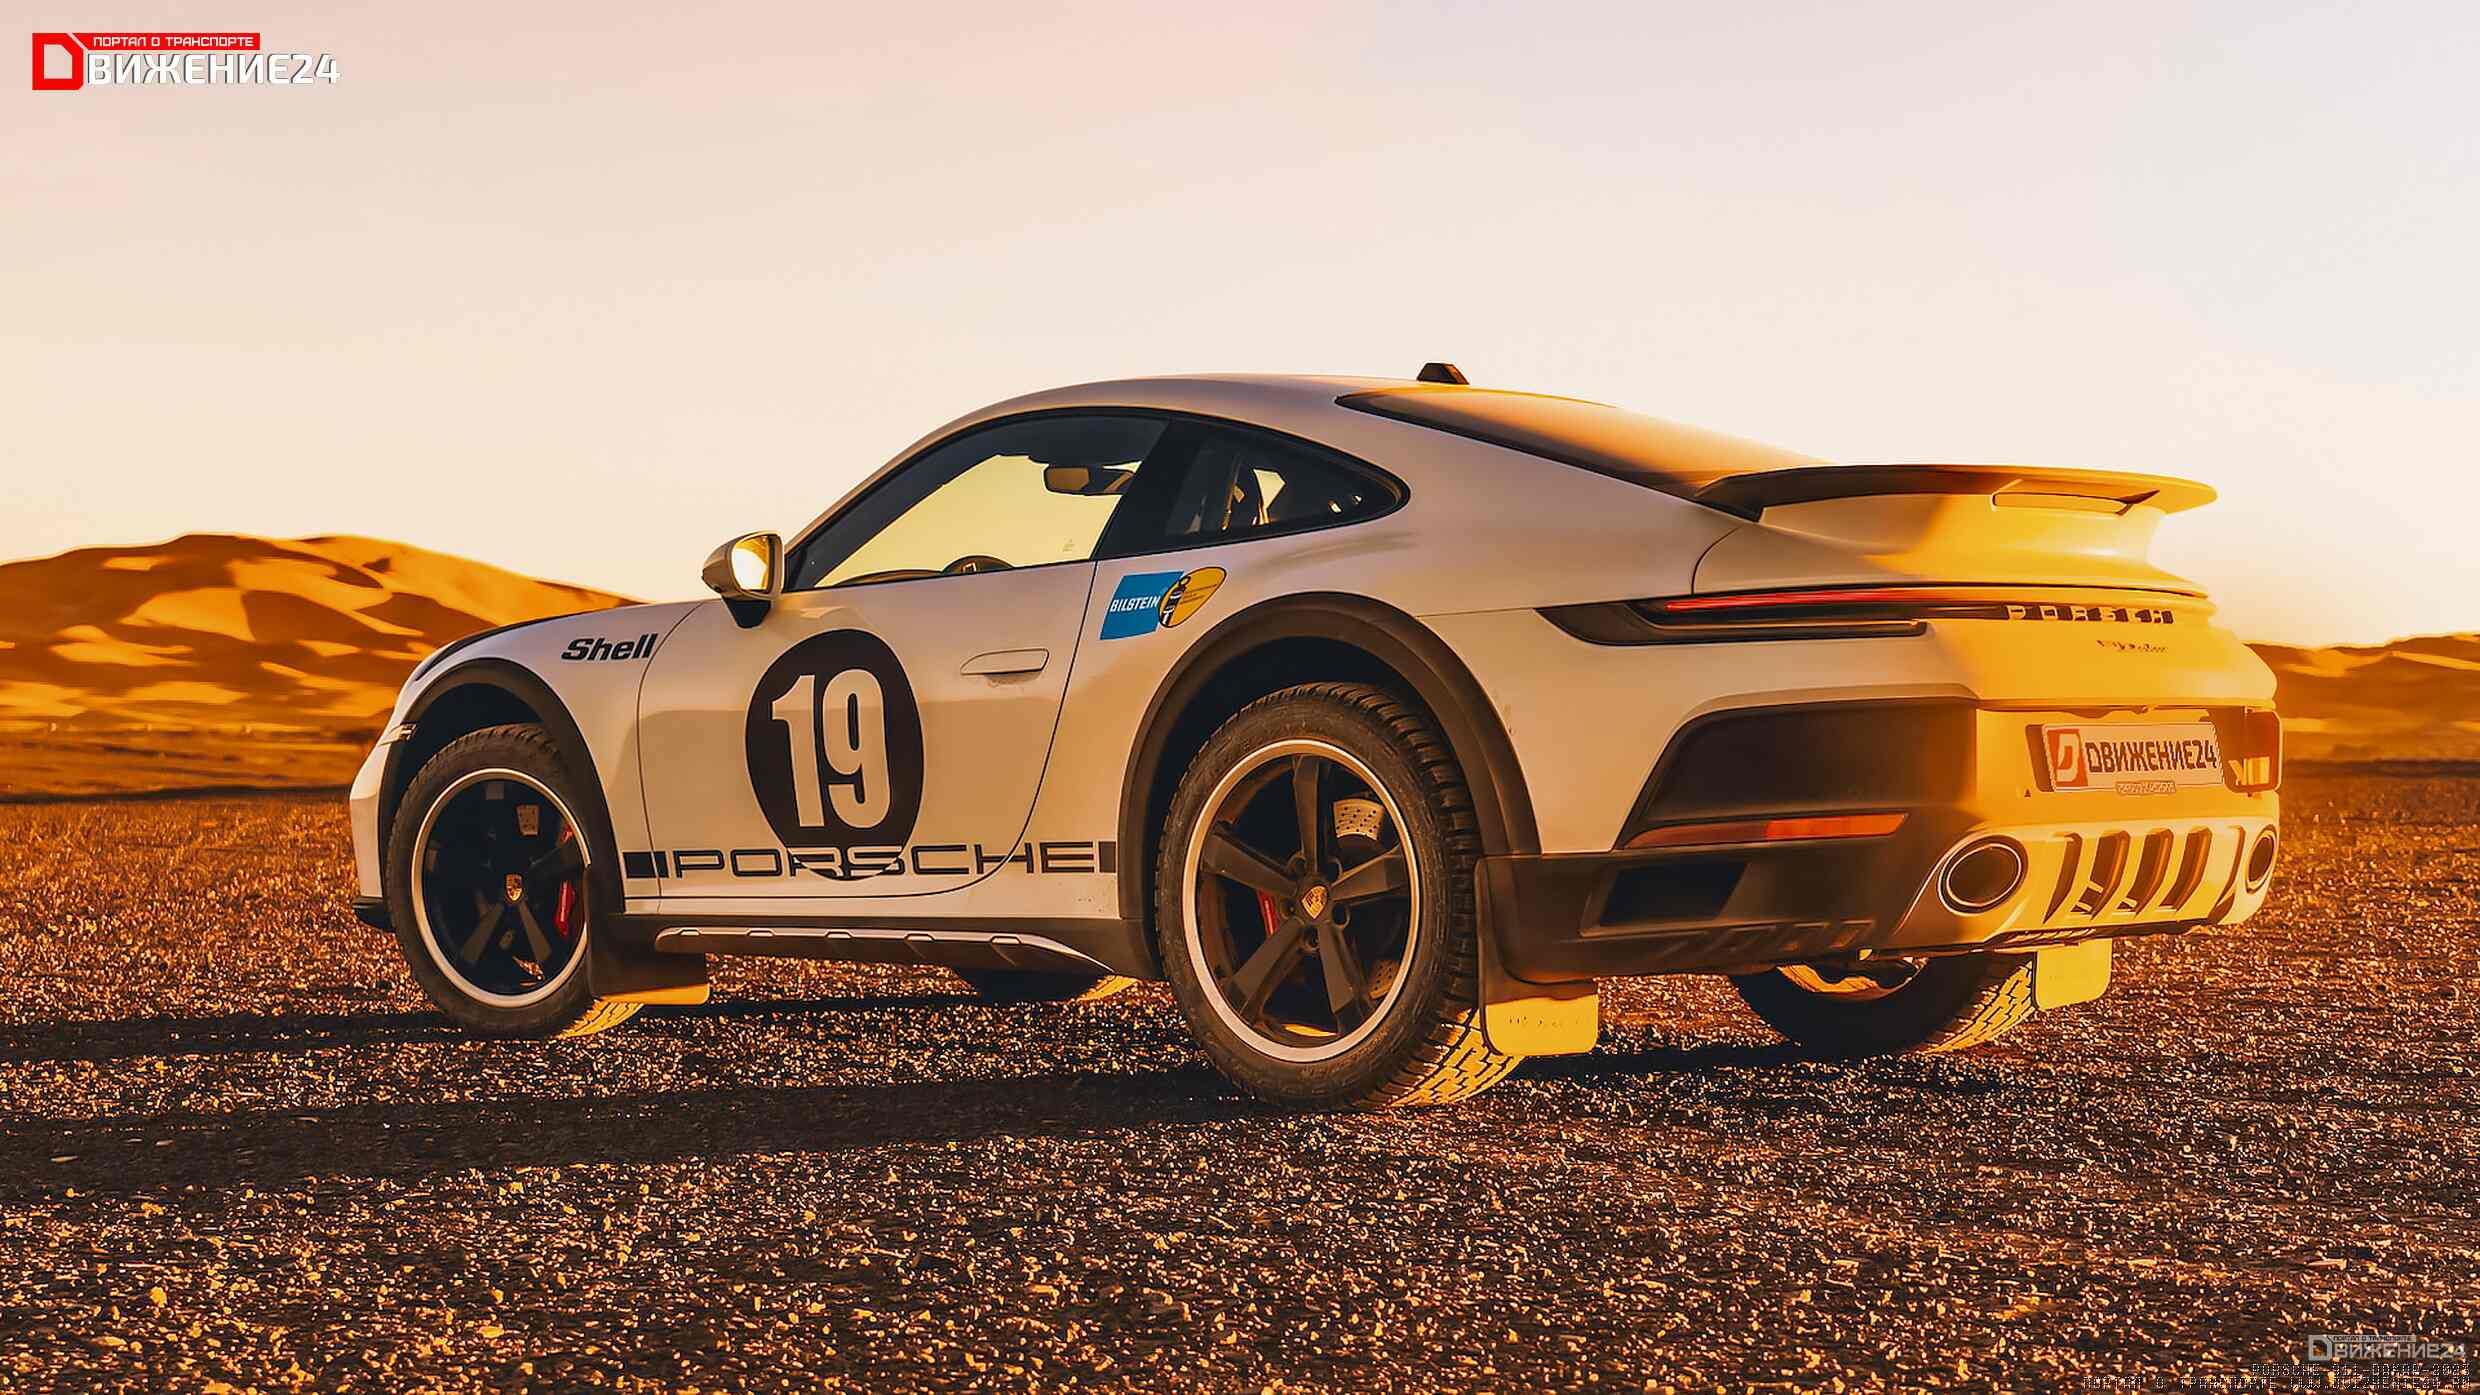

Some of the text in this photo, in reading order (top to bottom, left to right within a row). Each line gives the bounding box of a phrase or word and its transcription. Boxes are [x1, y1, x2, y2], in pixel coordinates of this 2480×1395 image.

[1109, 595, 1161, 613] BILSTEIN
[2006, 604, 2180, 625] PORSCH
[561, 633, 658, 661] Shell
[771, 668, 891, 829] 19
[673, 841, 1096, 878] PORSCHE
